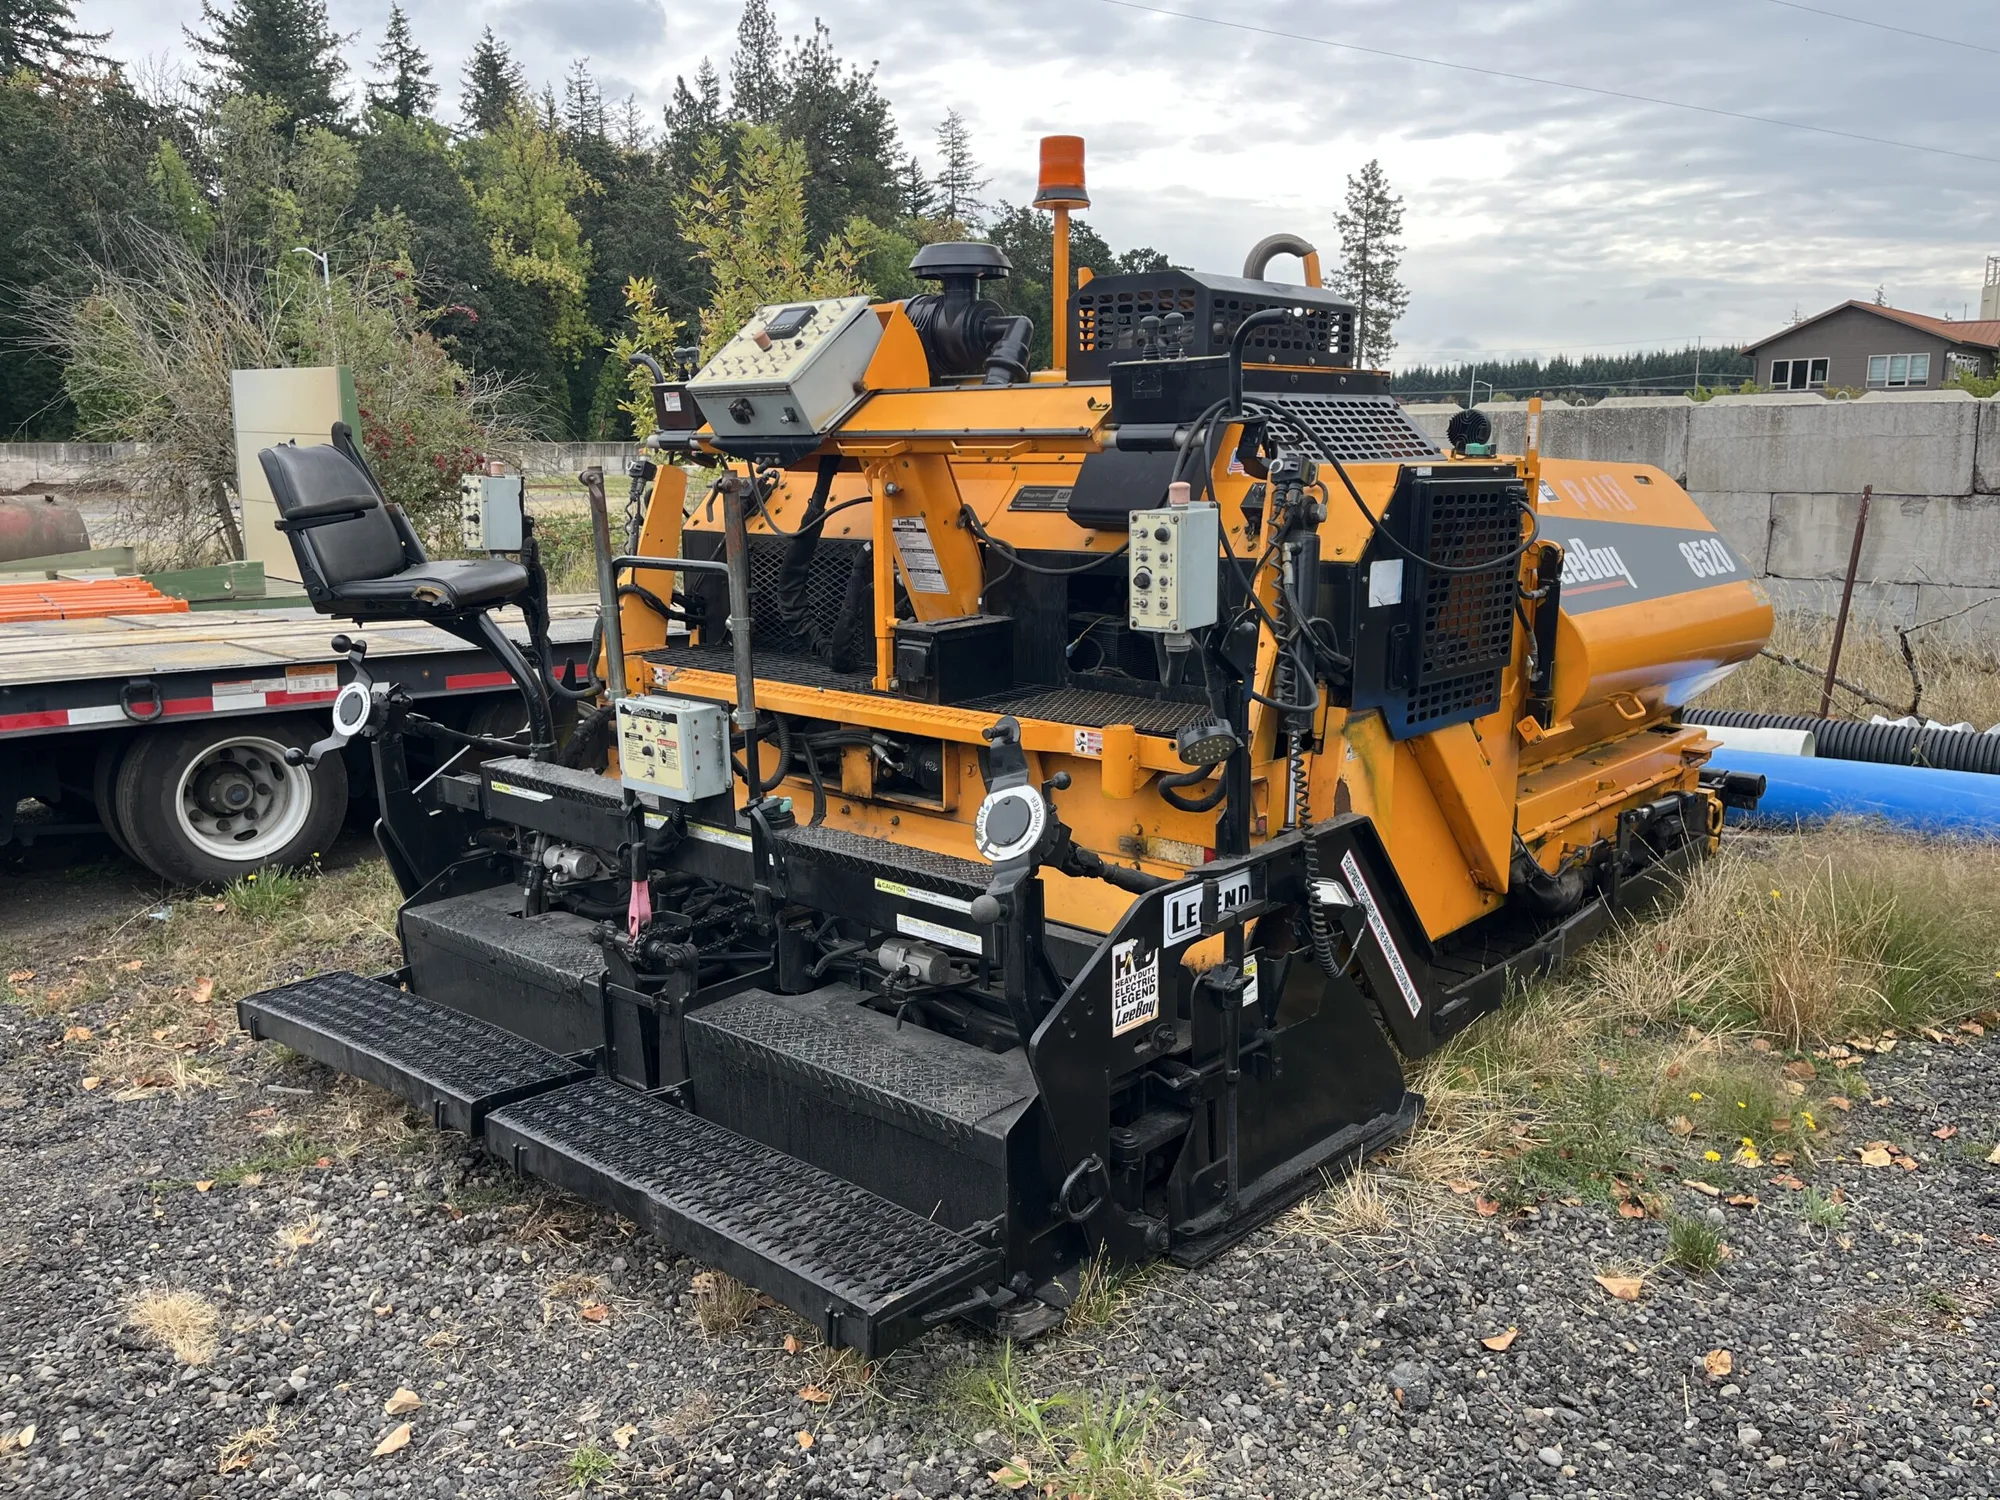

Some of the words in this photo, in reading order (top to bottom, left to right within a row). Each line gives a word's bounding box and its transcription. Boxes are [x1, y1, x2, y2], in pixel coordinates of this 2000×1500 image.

[1560, 538, 1638, 589] eeBoy
[1678, 537, 1736, 578] 8520
[1030, 796, 1042, 832] THICKER
[882, 882, 906, 894] CAUTION
[1172, 884, 1249, 934] LEND
[1115, 972, 1138, 989] HEAVY
[1138, 965, 1156, 979] DUTY
[1115, 974, 1156, 998] ELECTRIC
[1115, 983, 1156, 1010] LEGEND
[1115, 999, 1156, 1028] LeeBoy
